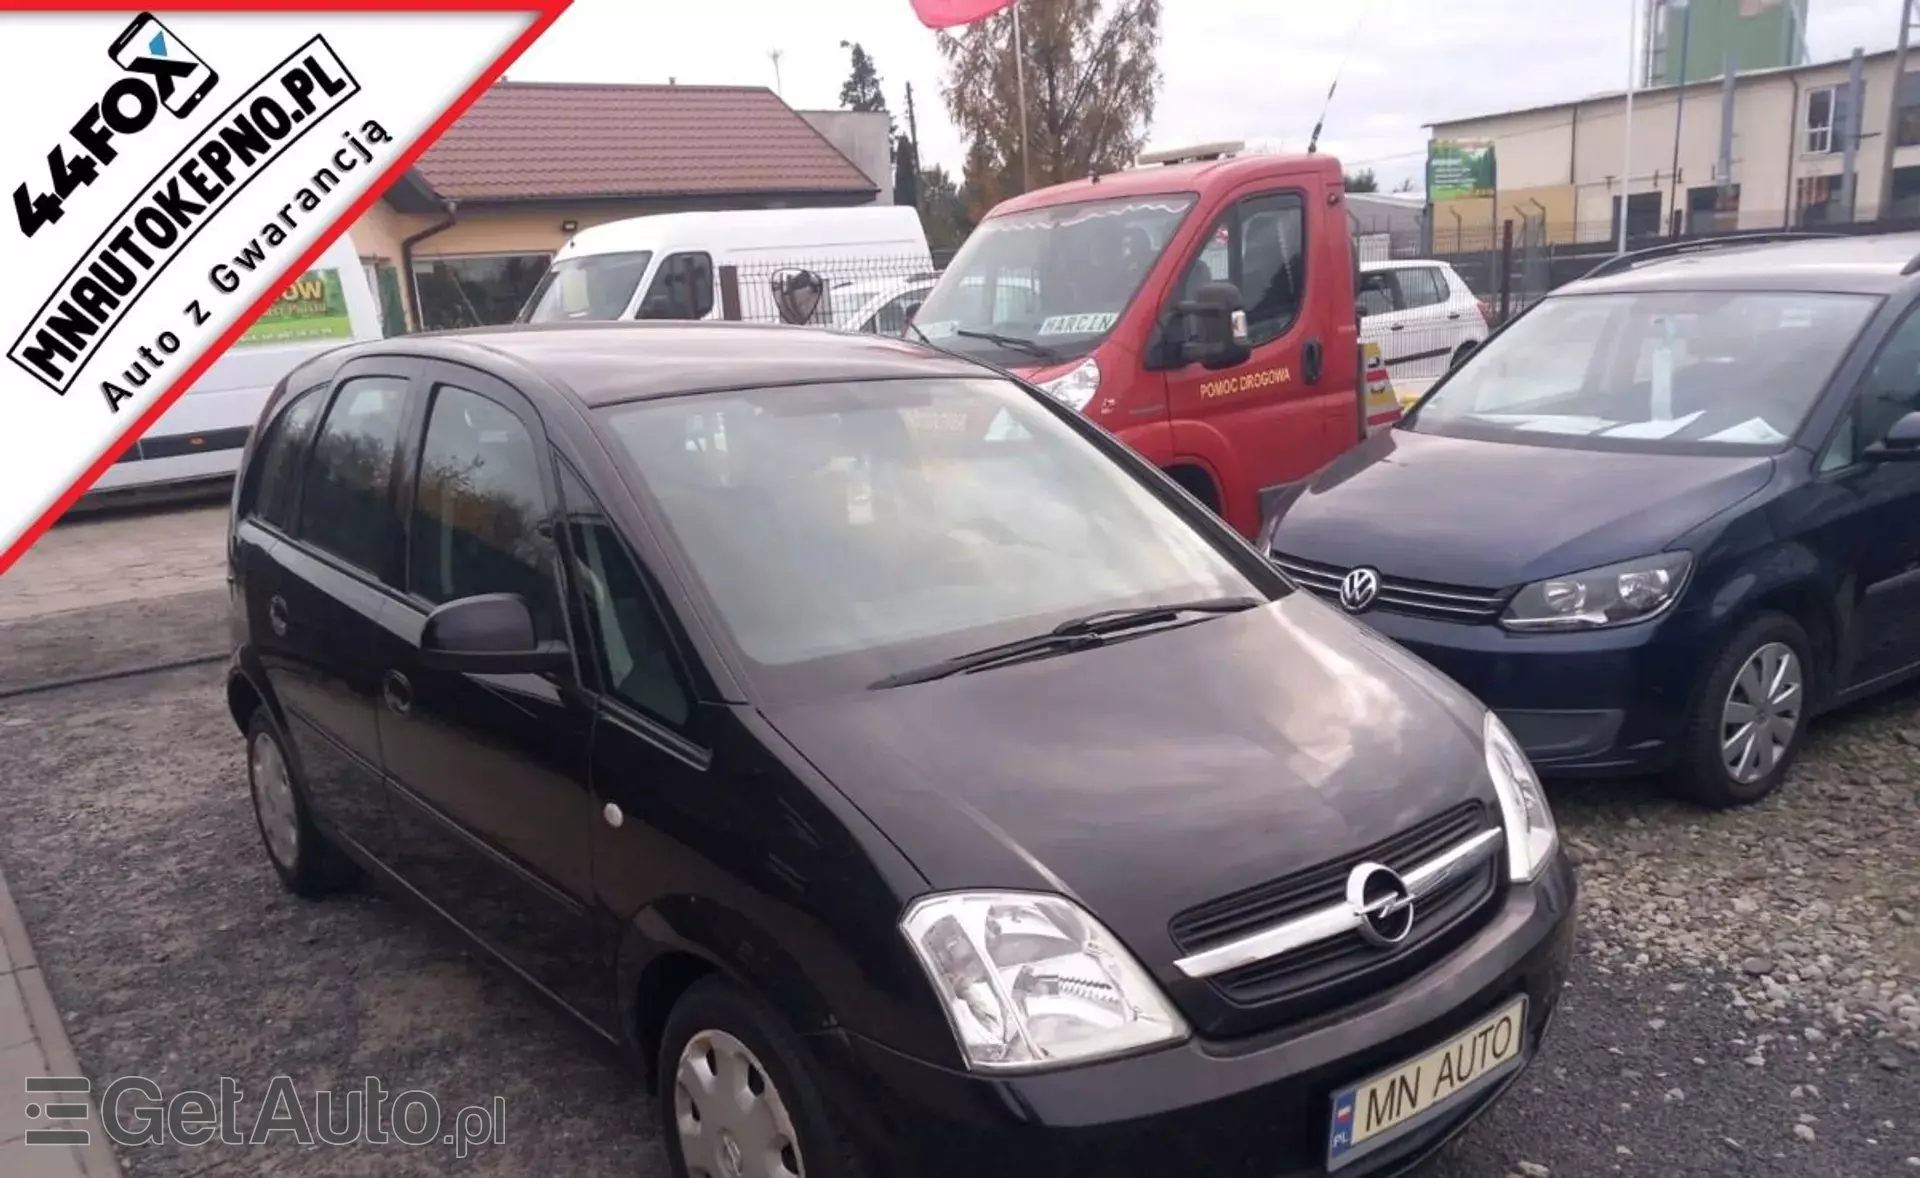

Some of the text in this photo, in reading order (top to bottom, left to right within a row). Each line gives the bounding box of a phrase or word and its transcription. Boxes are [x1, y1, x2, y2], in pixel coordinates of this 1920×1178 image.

[1200, 366, 1291, 400] POMOC DROGOWA
[1366, 1015, 1512, 1132] MN AUTO
